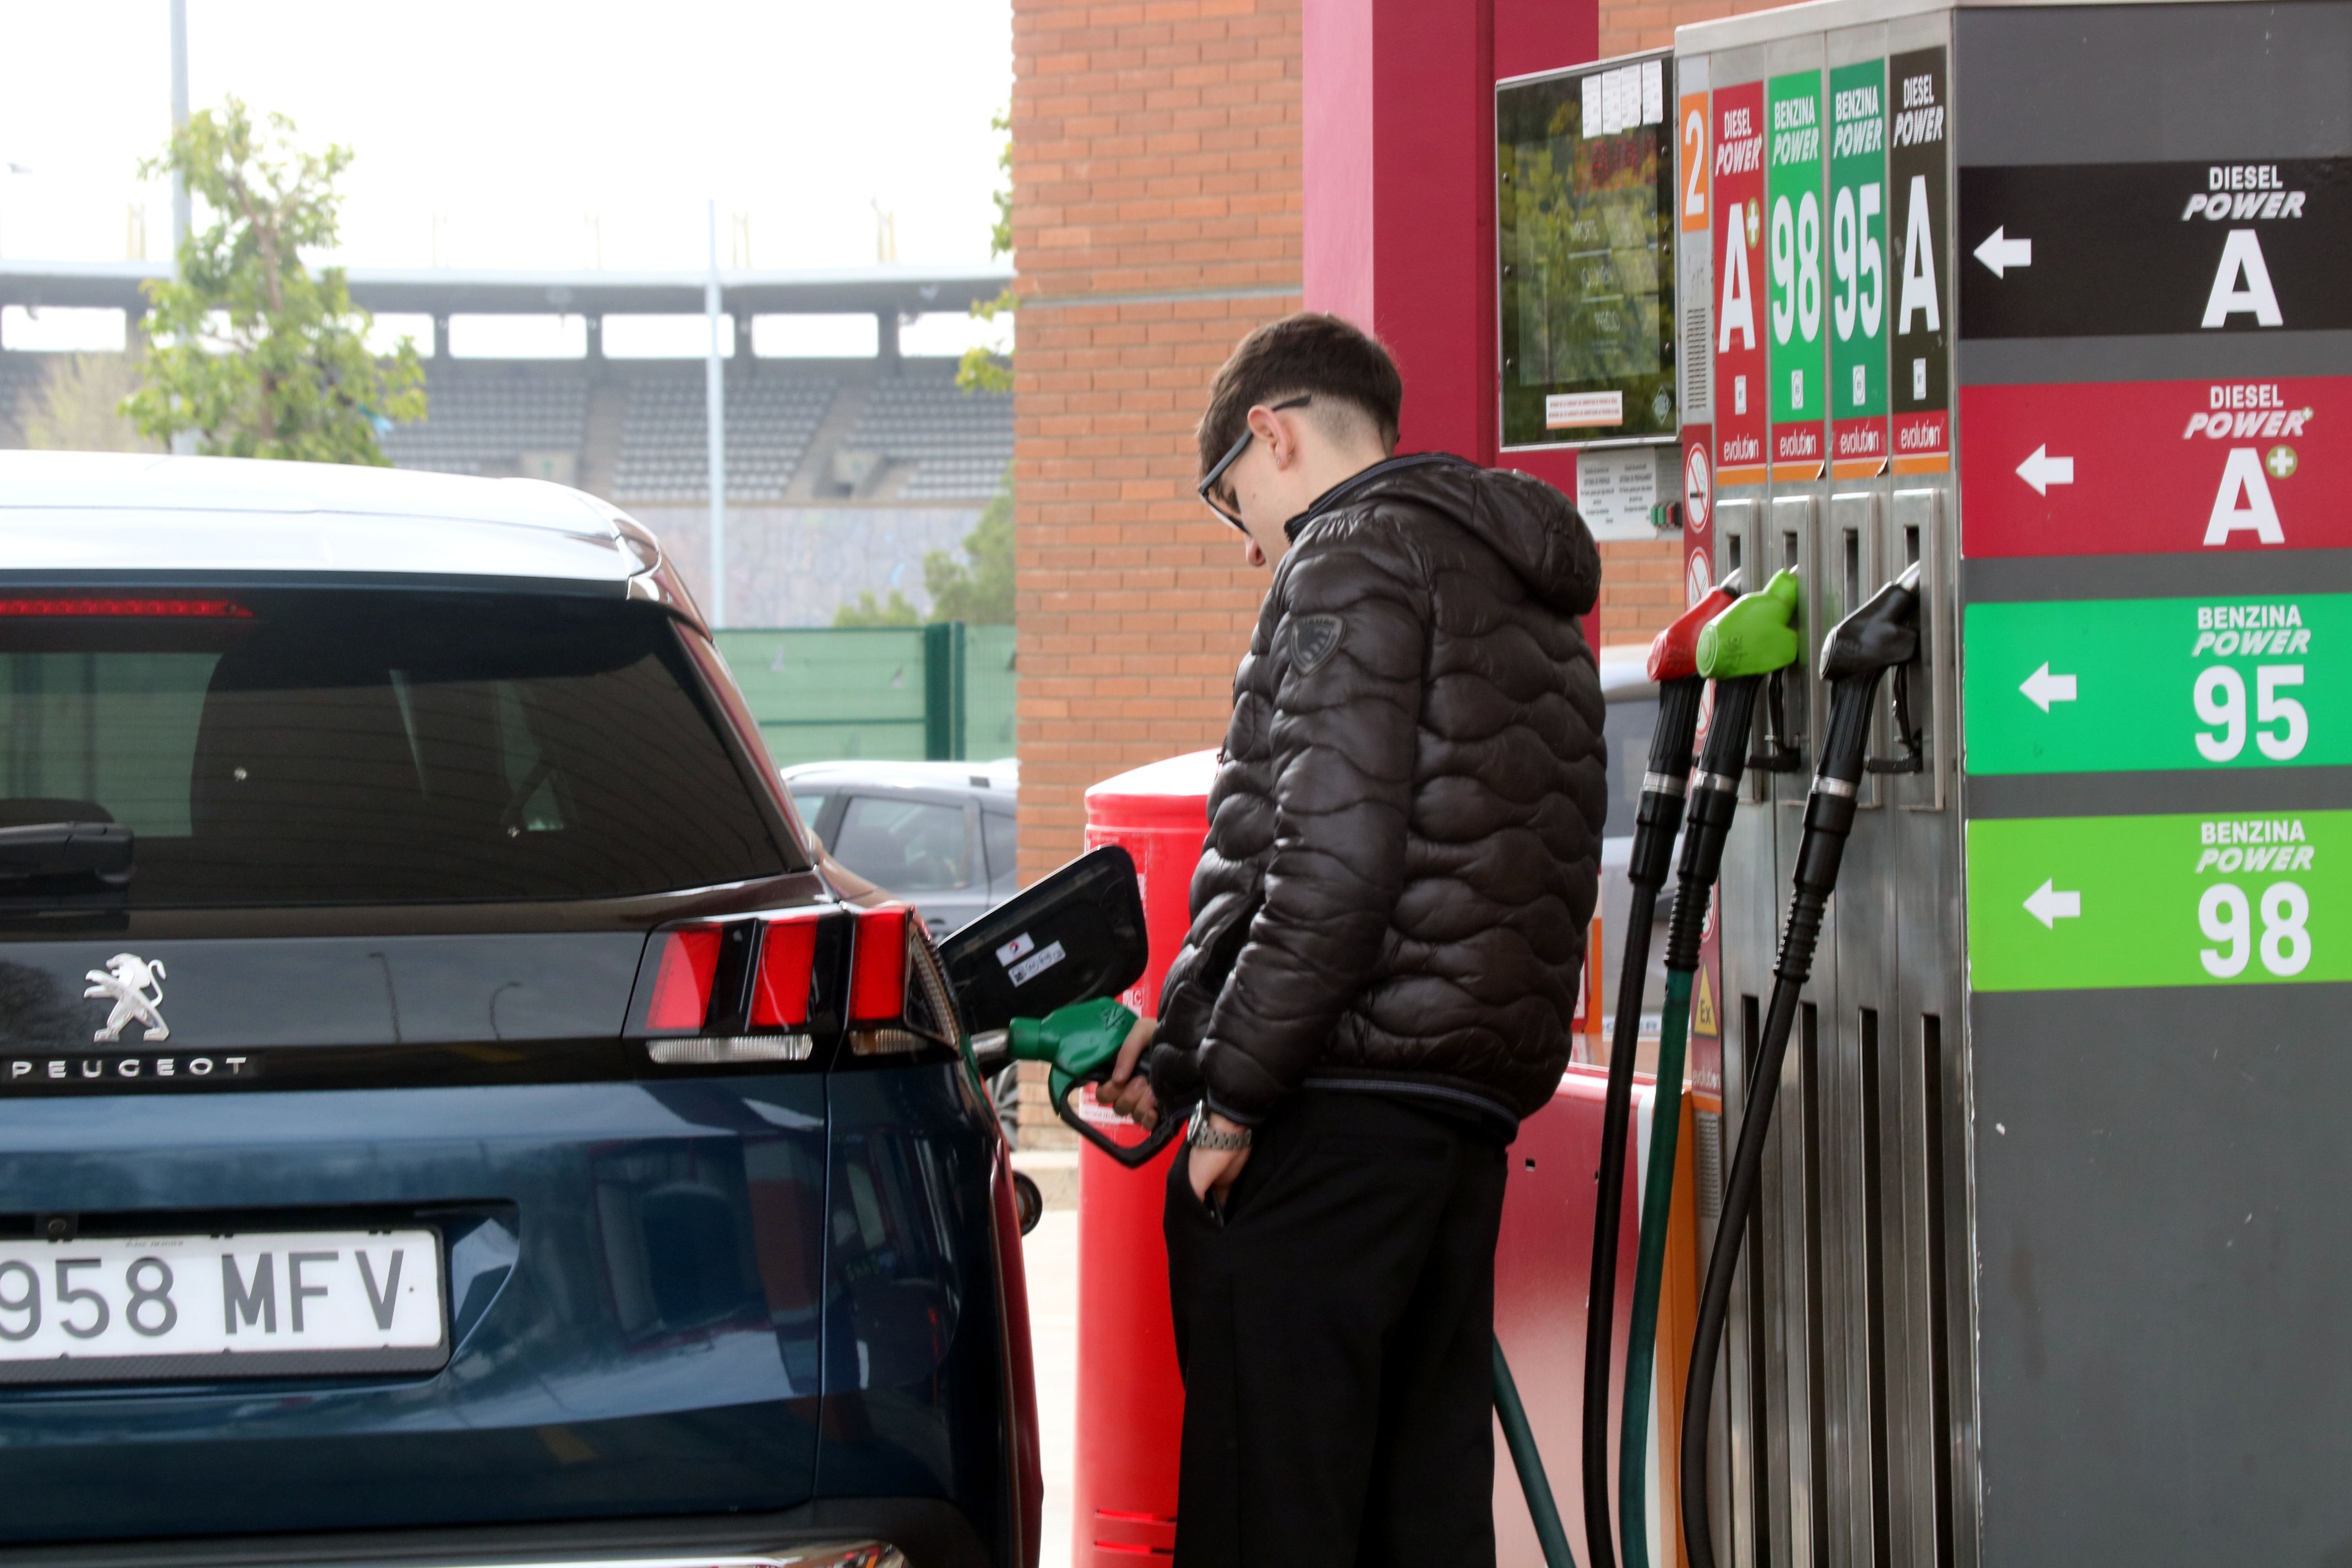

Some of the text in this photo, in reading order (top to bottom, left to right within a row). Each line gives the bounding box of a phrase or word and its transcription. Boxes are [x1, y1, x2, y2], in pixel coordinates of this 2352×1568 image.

[1836, 85, 1879, 121] BENZINA
[1904, 74, 1935, 104] DIESEL
[1724, 107, 1752, 140] DIESEL
[1775, 96, 1815, 127] BENZINA
[1894, 105, 1944, 148] POWER
[1772, 127, 1820, 166] POWER
[1833, 117, 1883, 159] POWER
[1686, 110, 1705, 216] 2
[2210, 166, 2283, 190] DIESEL
[2182, 191, 2306, 221] POWER
[1772, 190, 1821, 345] 98
[1834, 182, 1883, 341] 95
[1899, 175, 1940, 335] A
[2201, 229, 2283, 328] A
[2211, 384, 2284, 409] DIESEL
[2198, 605, 2302, 630] BENZINA
[2192, 629, 2311, 657] POWER
[2193, 665, 2309, 762] 95
[2201, 819, 2306, 845] BENZINA
[2195, 846, 2315, 874] POWER
[2198, 881, 2312, 978] 98
[1700, 998, 1711, 1025] Ex
[12, 1057, 247, 1079] PEUGEOT
[0, 1250, 404, 1341] 958 MFV
